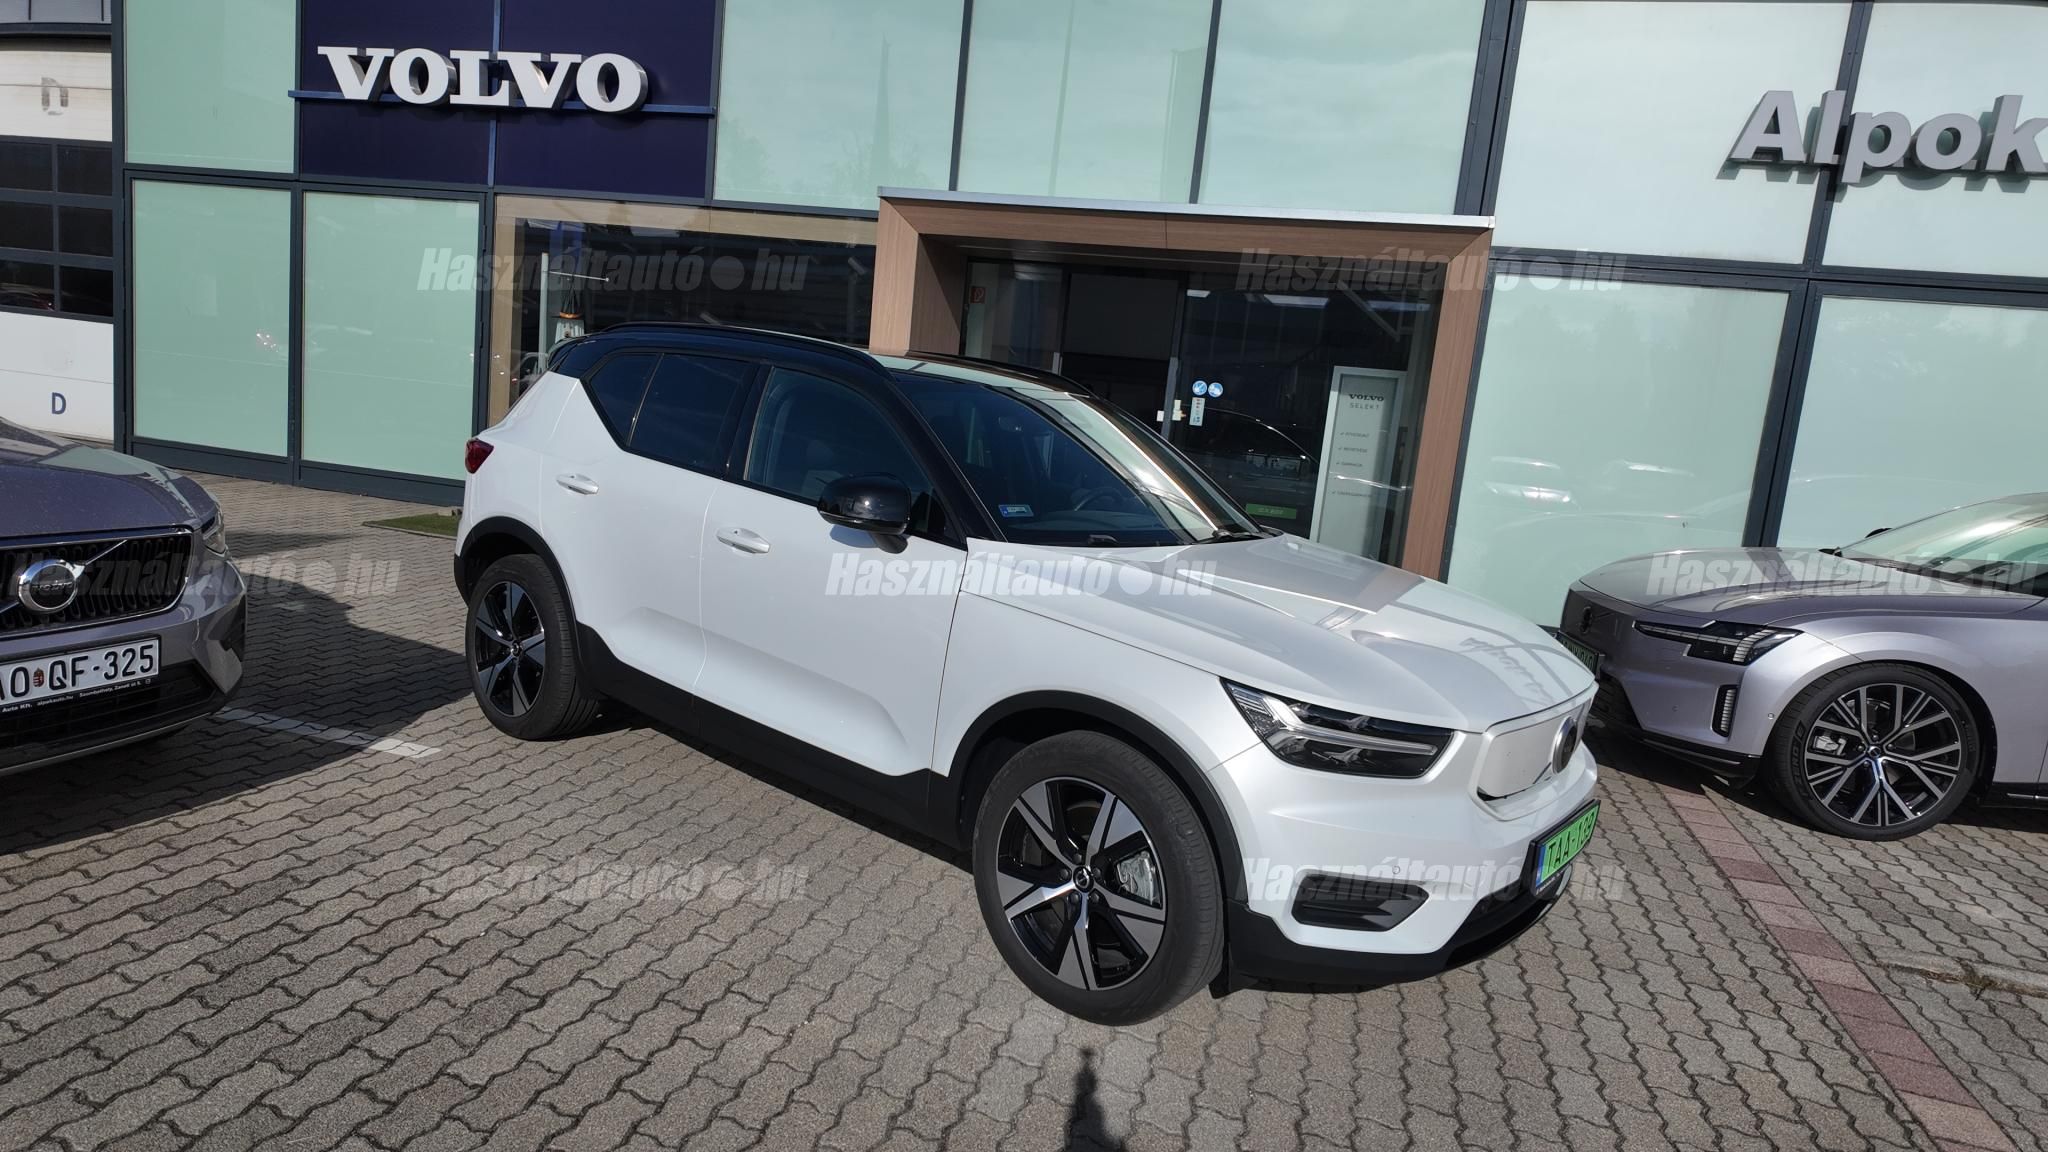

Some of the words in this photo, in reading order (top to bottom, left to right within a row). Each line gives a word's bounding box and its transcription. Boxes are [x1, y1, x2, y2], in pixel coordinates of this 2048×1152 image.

[318, 46, 649, 113] VOLVO
[51, 391, 67, 415] D
[1349, 393, 1384, 402] VOLVO
[48, 644, 154, 691] QF-325
